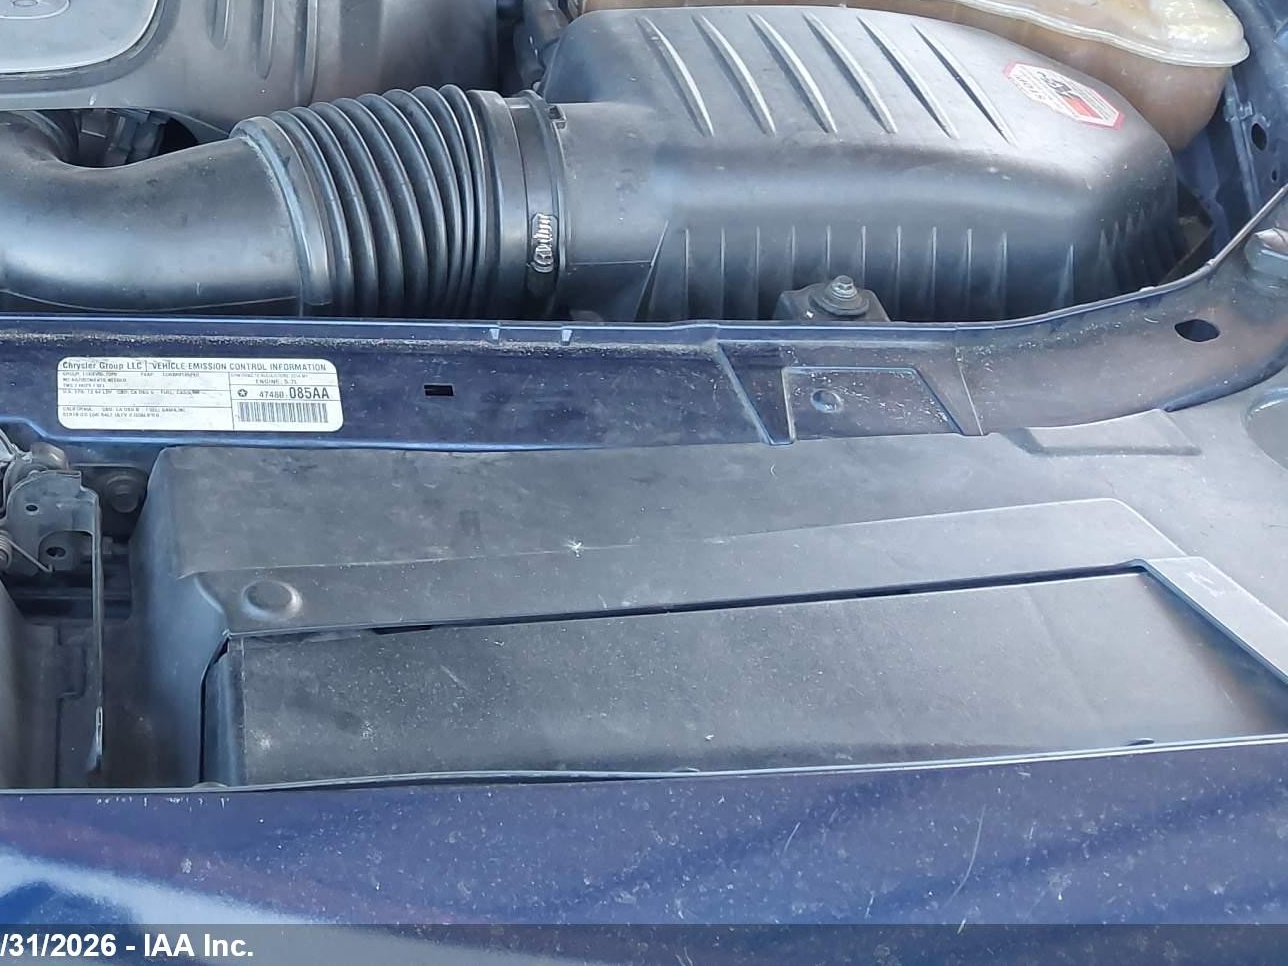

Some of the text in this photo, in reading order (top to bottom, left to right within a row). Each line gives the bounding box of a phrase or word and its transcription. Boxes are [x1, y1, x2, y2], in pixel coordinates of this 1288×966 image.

[62, 361, 327, 372] Chrysler Group LLC VEHICLE EMISSION CONTROL INFORMATION
[289, 386, 330, 400] 085AA
